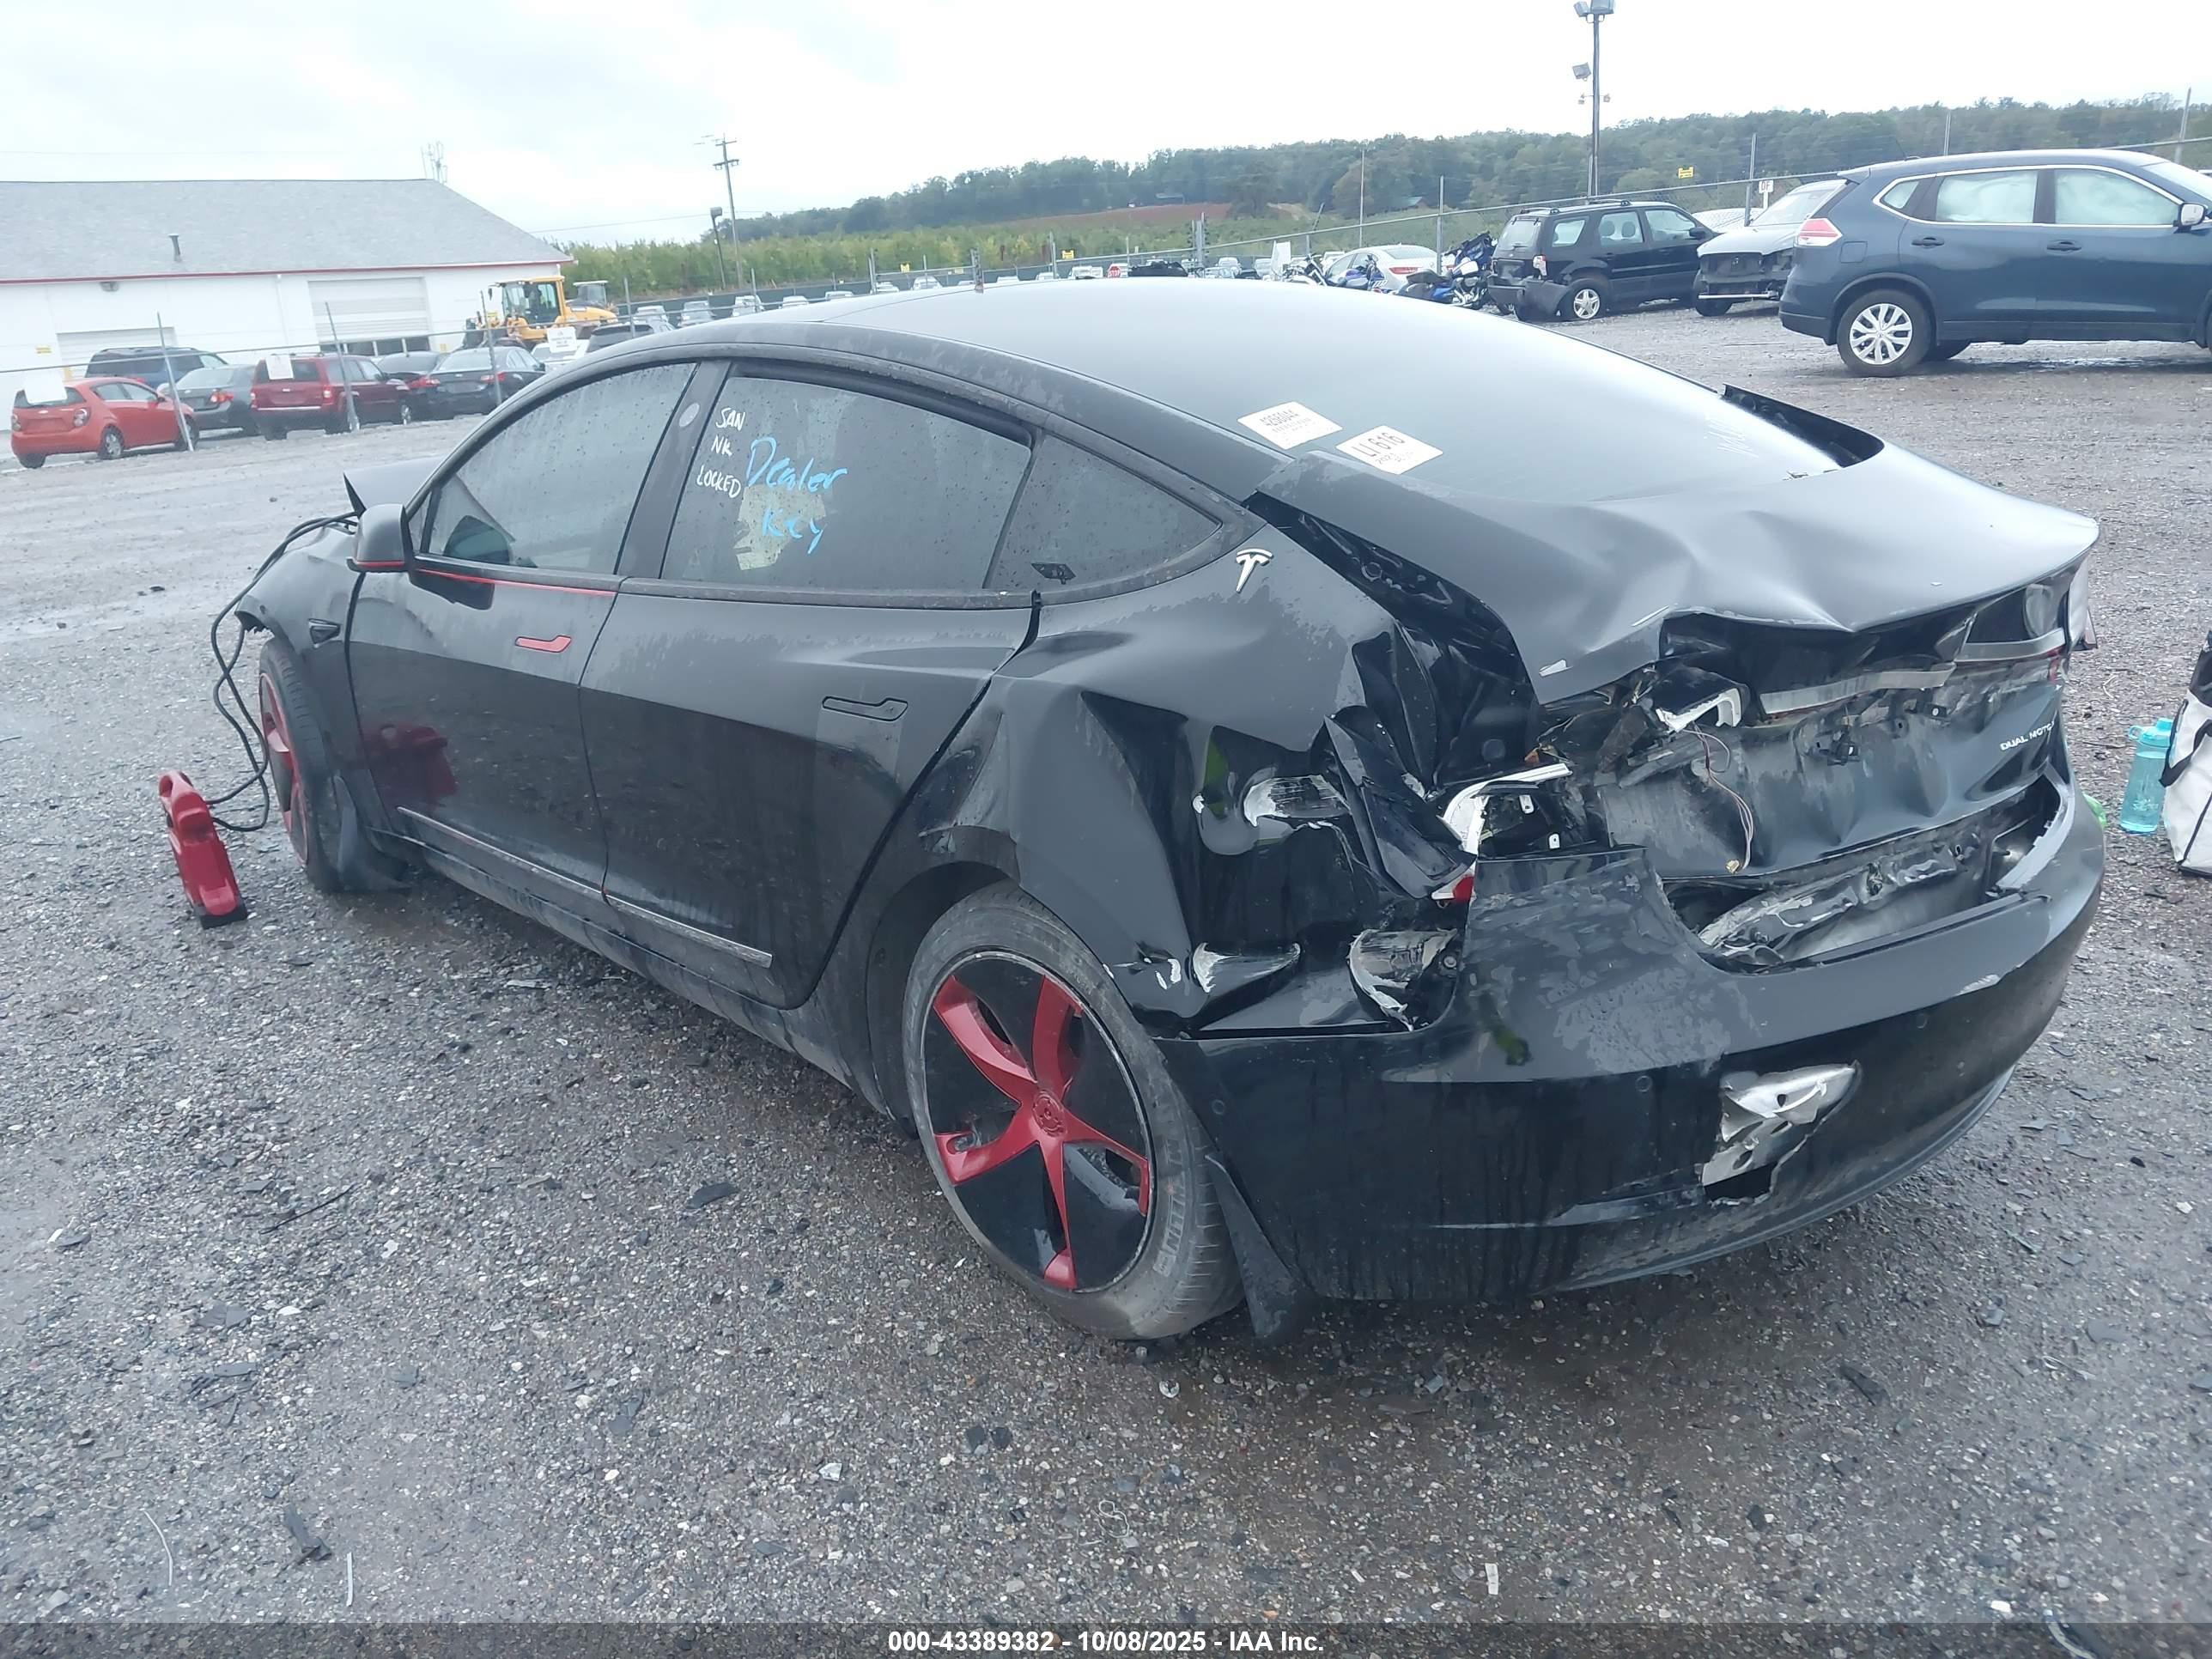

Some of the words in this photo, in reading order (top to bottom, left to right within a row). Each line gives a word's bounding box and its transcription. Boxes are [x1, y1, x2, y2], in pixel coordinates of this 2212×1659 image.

[715, 407, 745, 431] SAN
[746, 436, 848, 492] Dealer
[696, 465, 741, 499] LOCKED
[2000, 735, 2029, 750] DUAL
